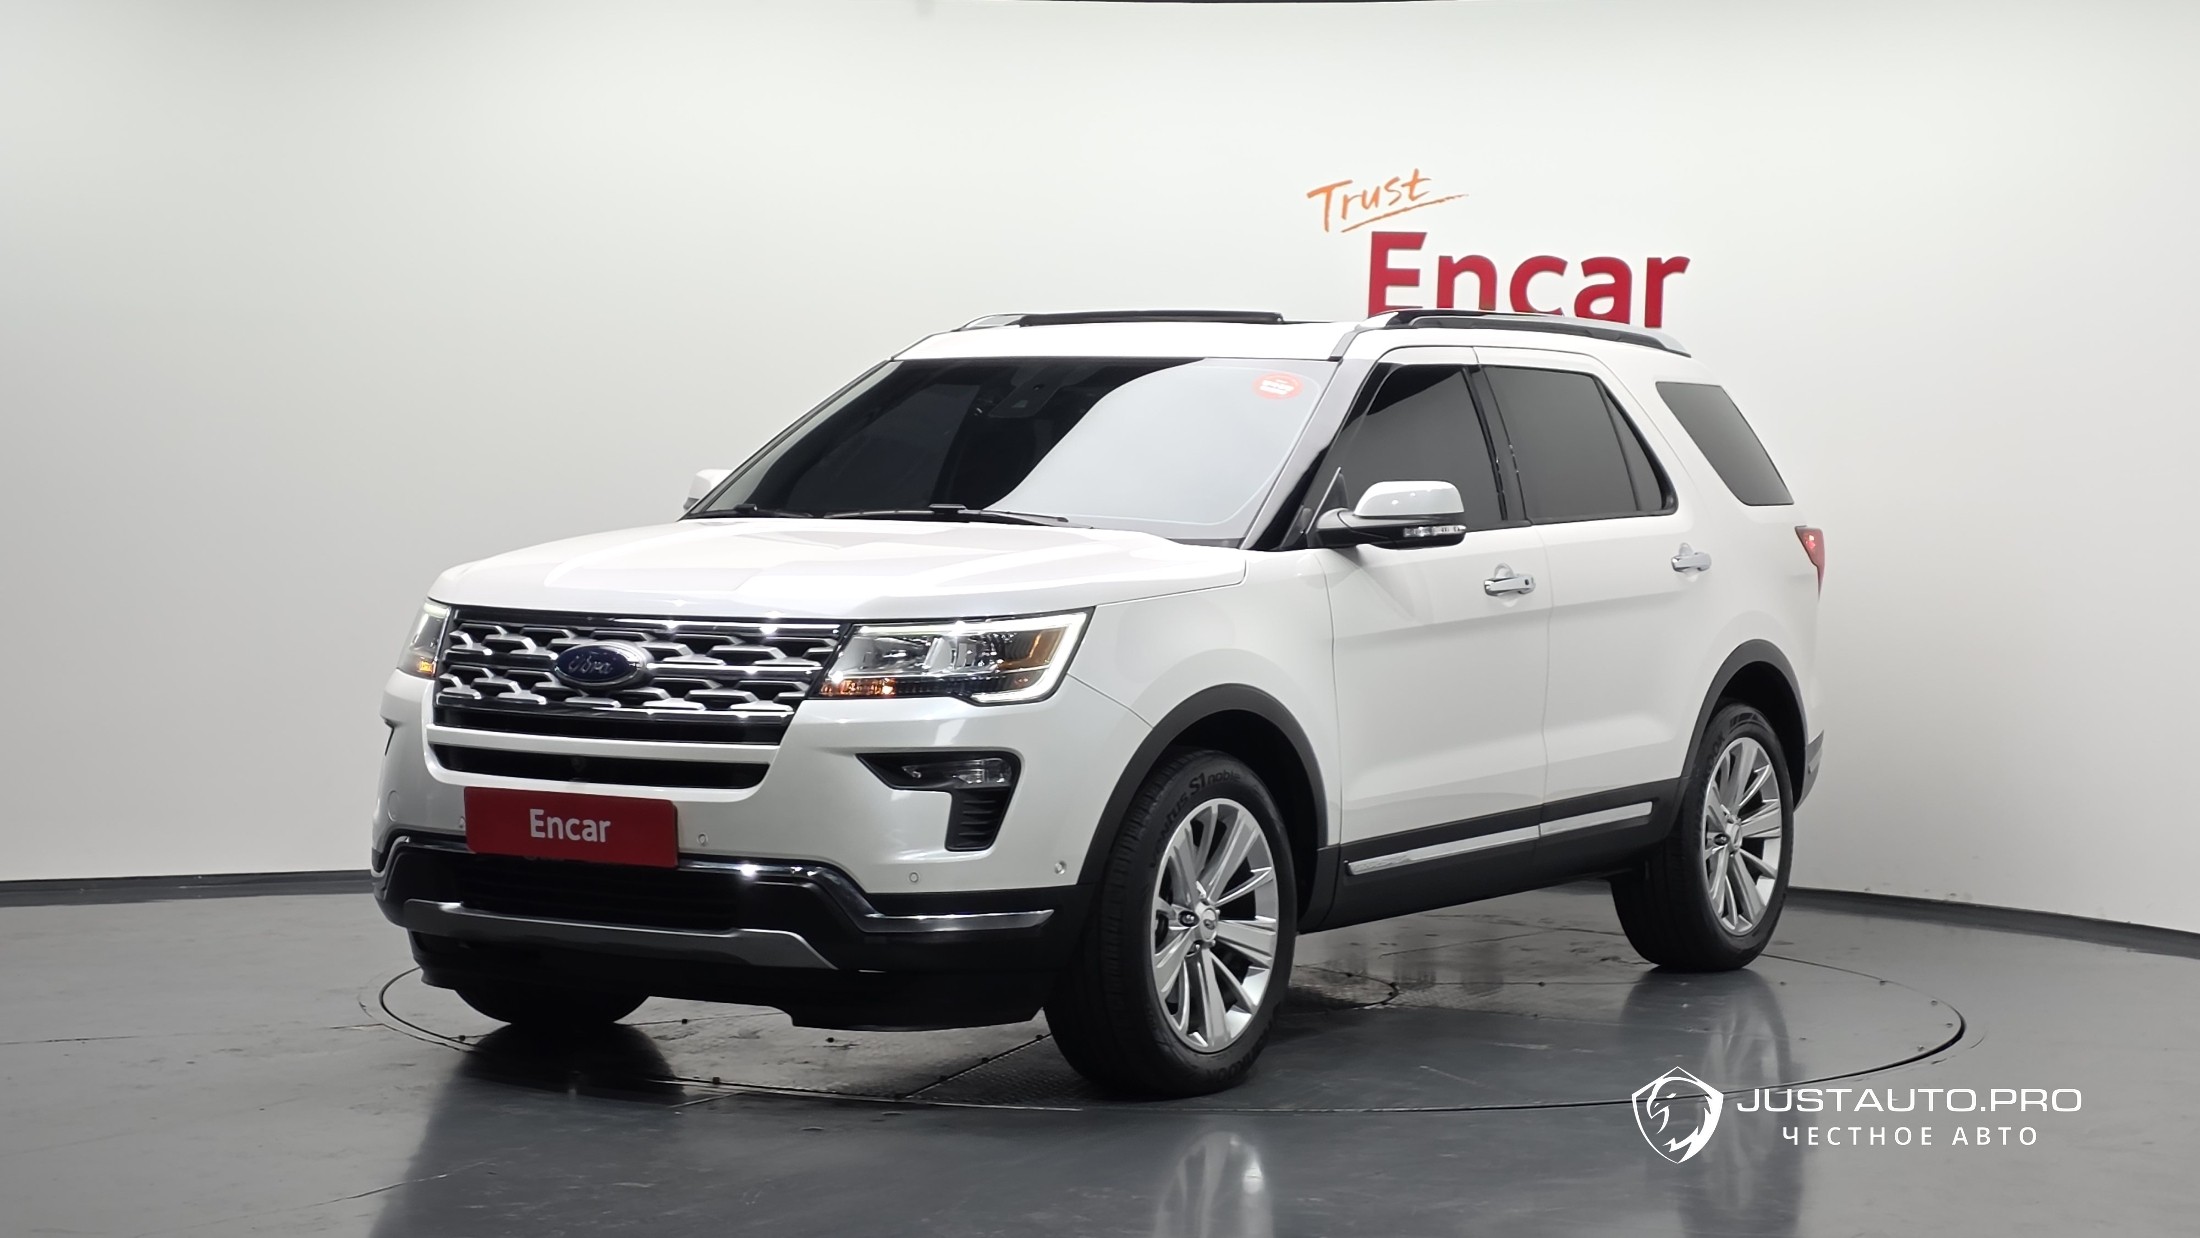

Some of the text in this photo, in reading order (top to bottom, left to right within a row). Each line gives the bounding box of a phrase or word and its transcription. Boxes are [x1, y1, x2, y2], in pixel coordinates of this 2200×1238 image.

[1306, 168, 1433, 232] Trust
[1367, 231, 1690, 328] Encar
[1188, 773, 1207, 796] S1
[529, 808, 611, 843] Encar
